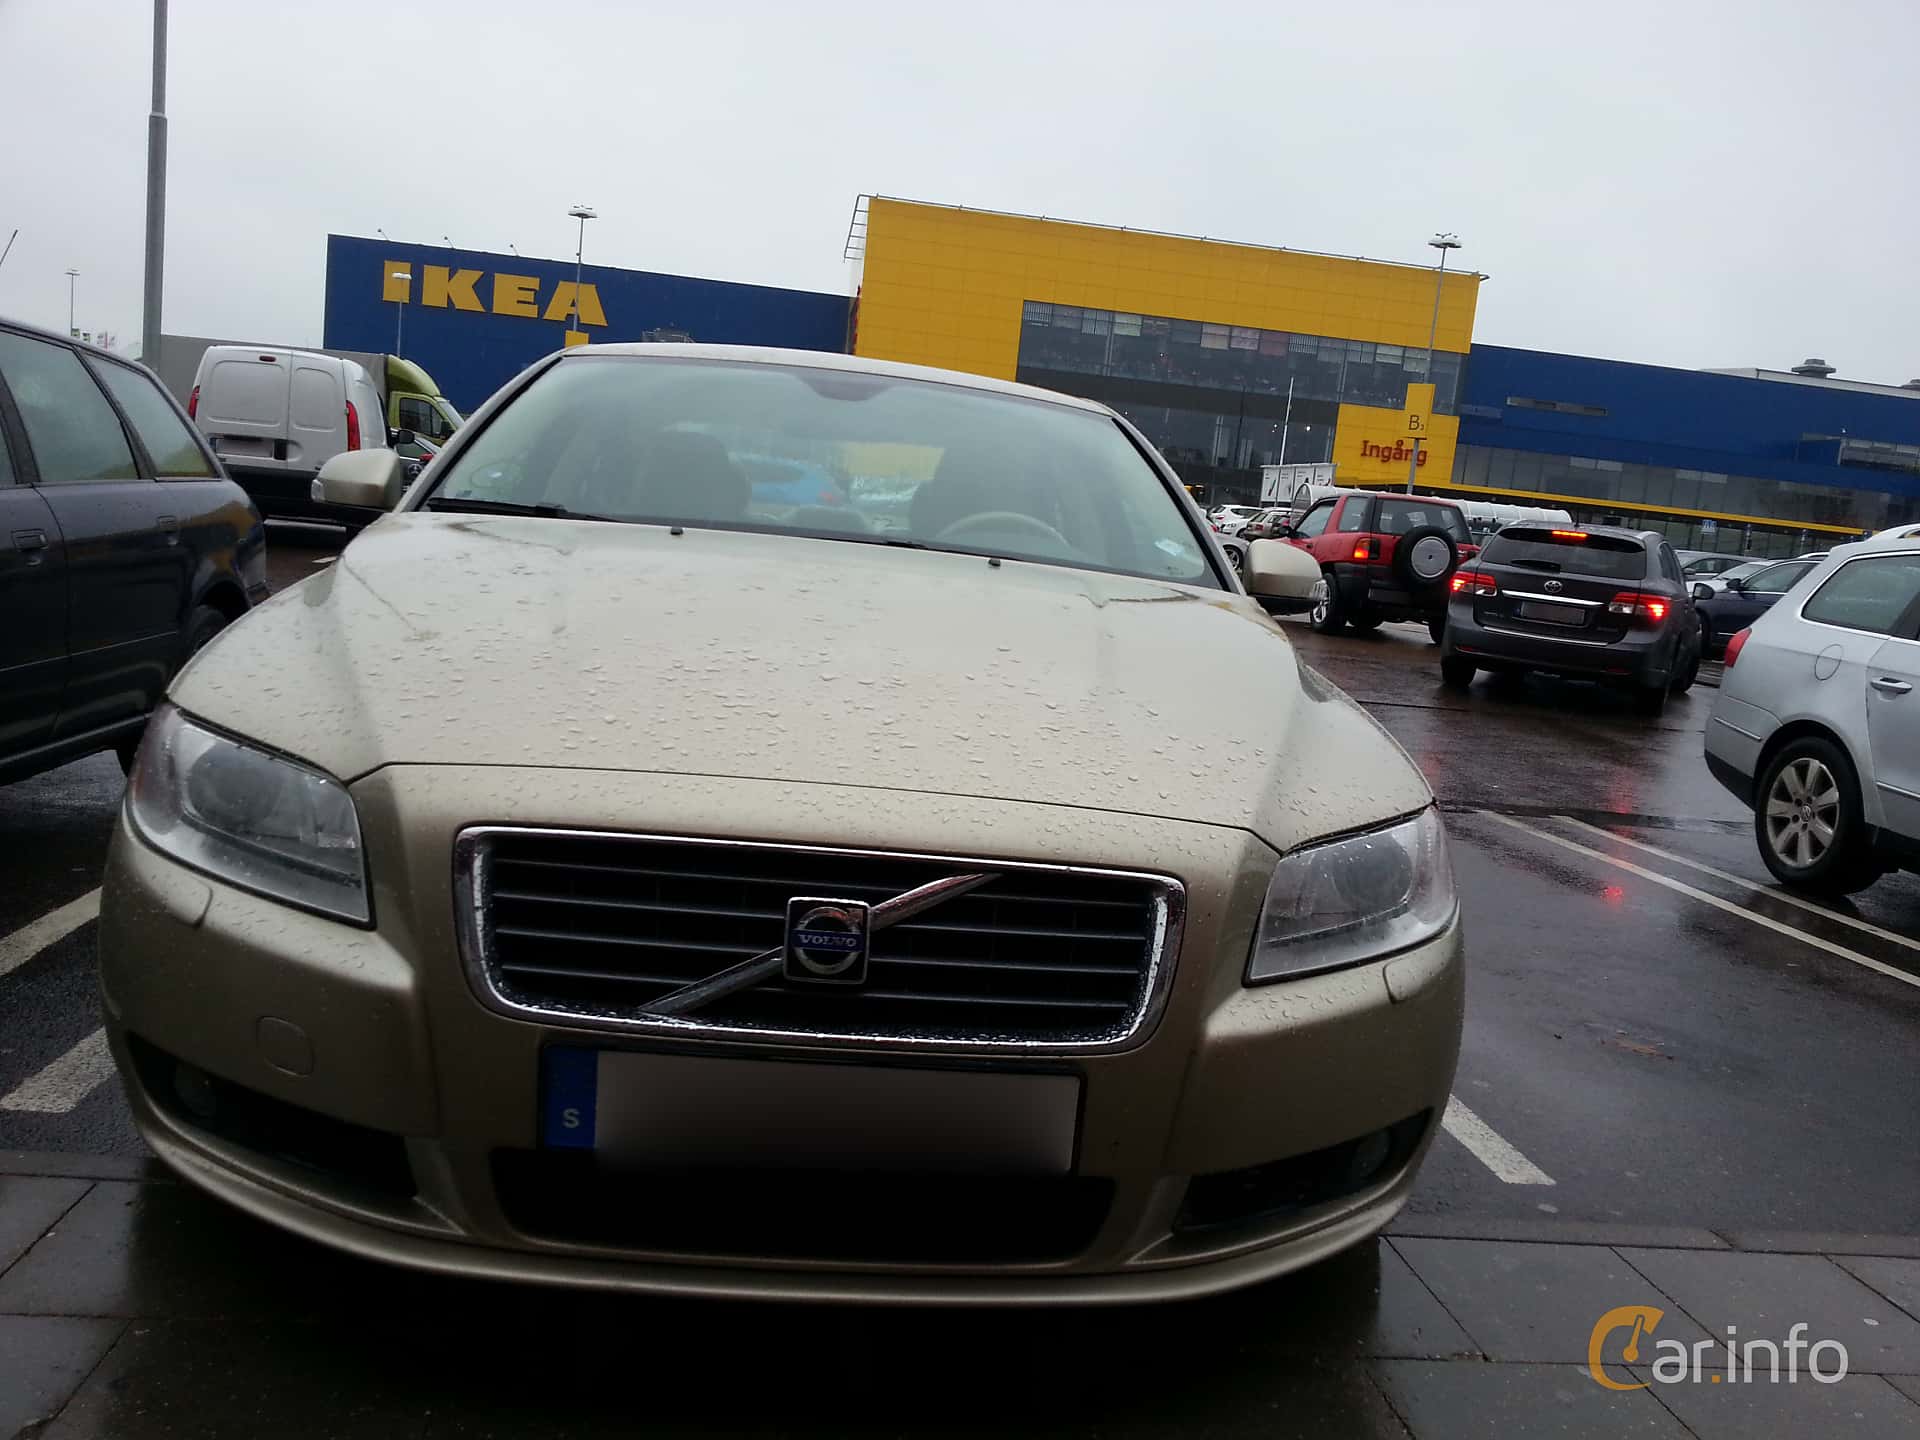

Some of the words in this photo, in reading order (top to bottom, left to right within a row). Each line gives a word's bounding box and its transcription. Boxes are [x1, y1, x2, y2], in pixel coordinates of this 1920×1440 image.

[382, 260, 609, 327] IKEA
[799, 933, 857, 948] VOLVO
[562, 1108, 580, 1128] S
